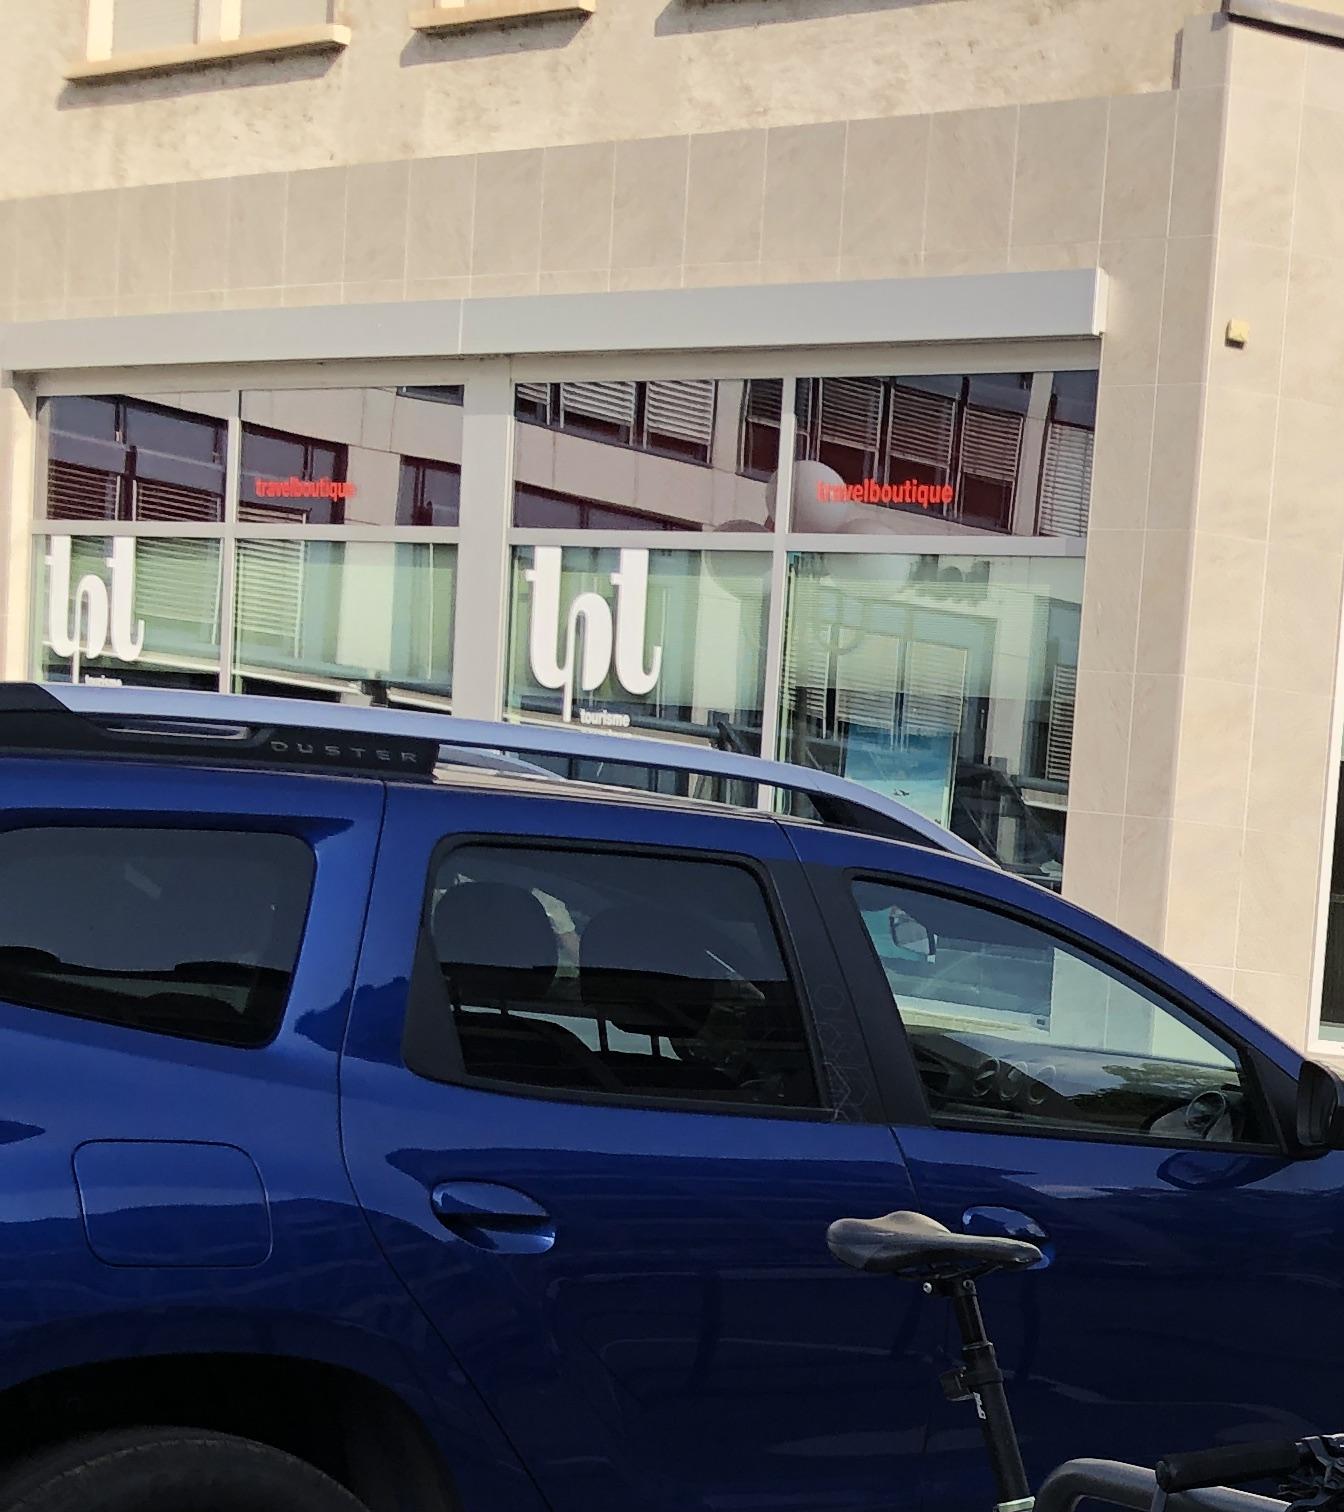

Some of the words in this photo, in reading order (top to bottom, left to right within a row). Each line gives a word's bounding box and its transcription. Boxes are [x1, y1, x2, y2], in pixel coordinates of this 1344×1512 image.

[255, 476, 357, 503] travelboutique
[816, 478, 954, 510] travelboutique
[579, 707, 631, 728] tourisme
[270, 740, 417, 764] DUSTER
